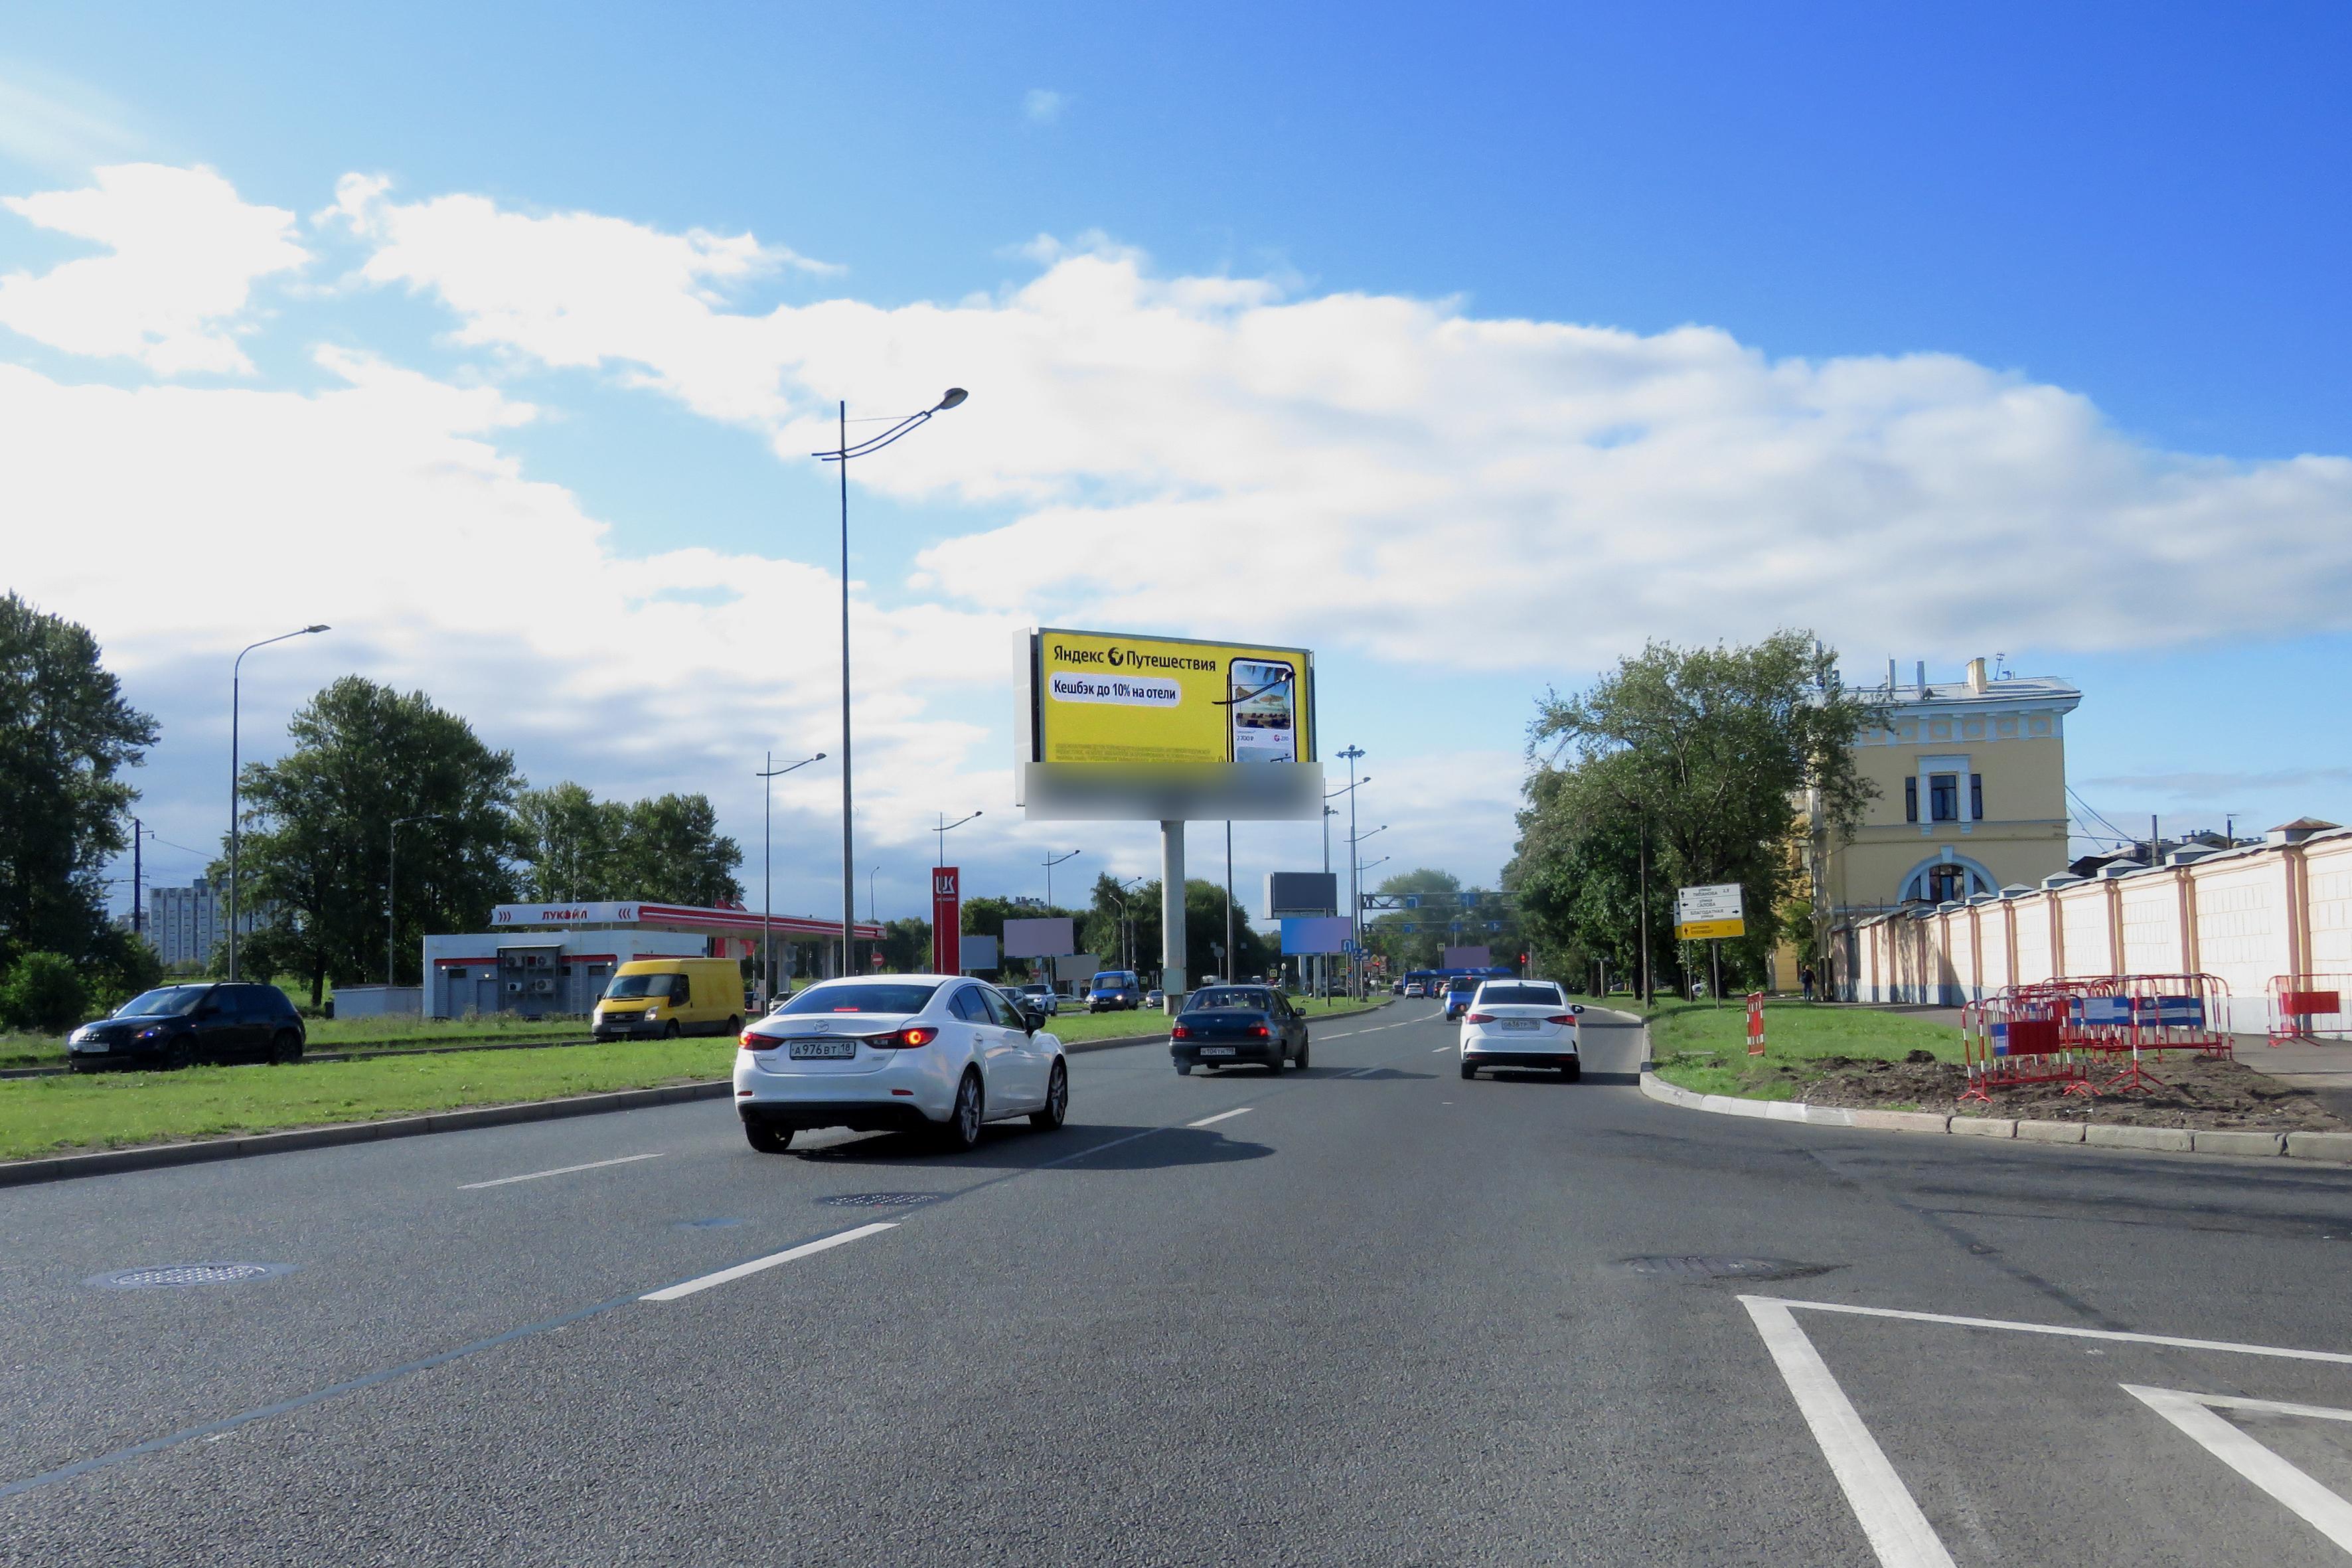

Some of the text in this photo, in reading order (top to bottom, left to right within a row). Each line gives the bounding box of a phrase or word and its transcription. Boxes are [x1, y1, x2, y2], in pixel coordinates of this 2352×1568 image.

[1054, 645, 1215, 671] Яндекс Путешествия
[1054, 679, 1176, 699] Кешбэк до 10% на отели
[795, 1043, 850, 1054] А976ВТ 18
